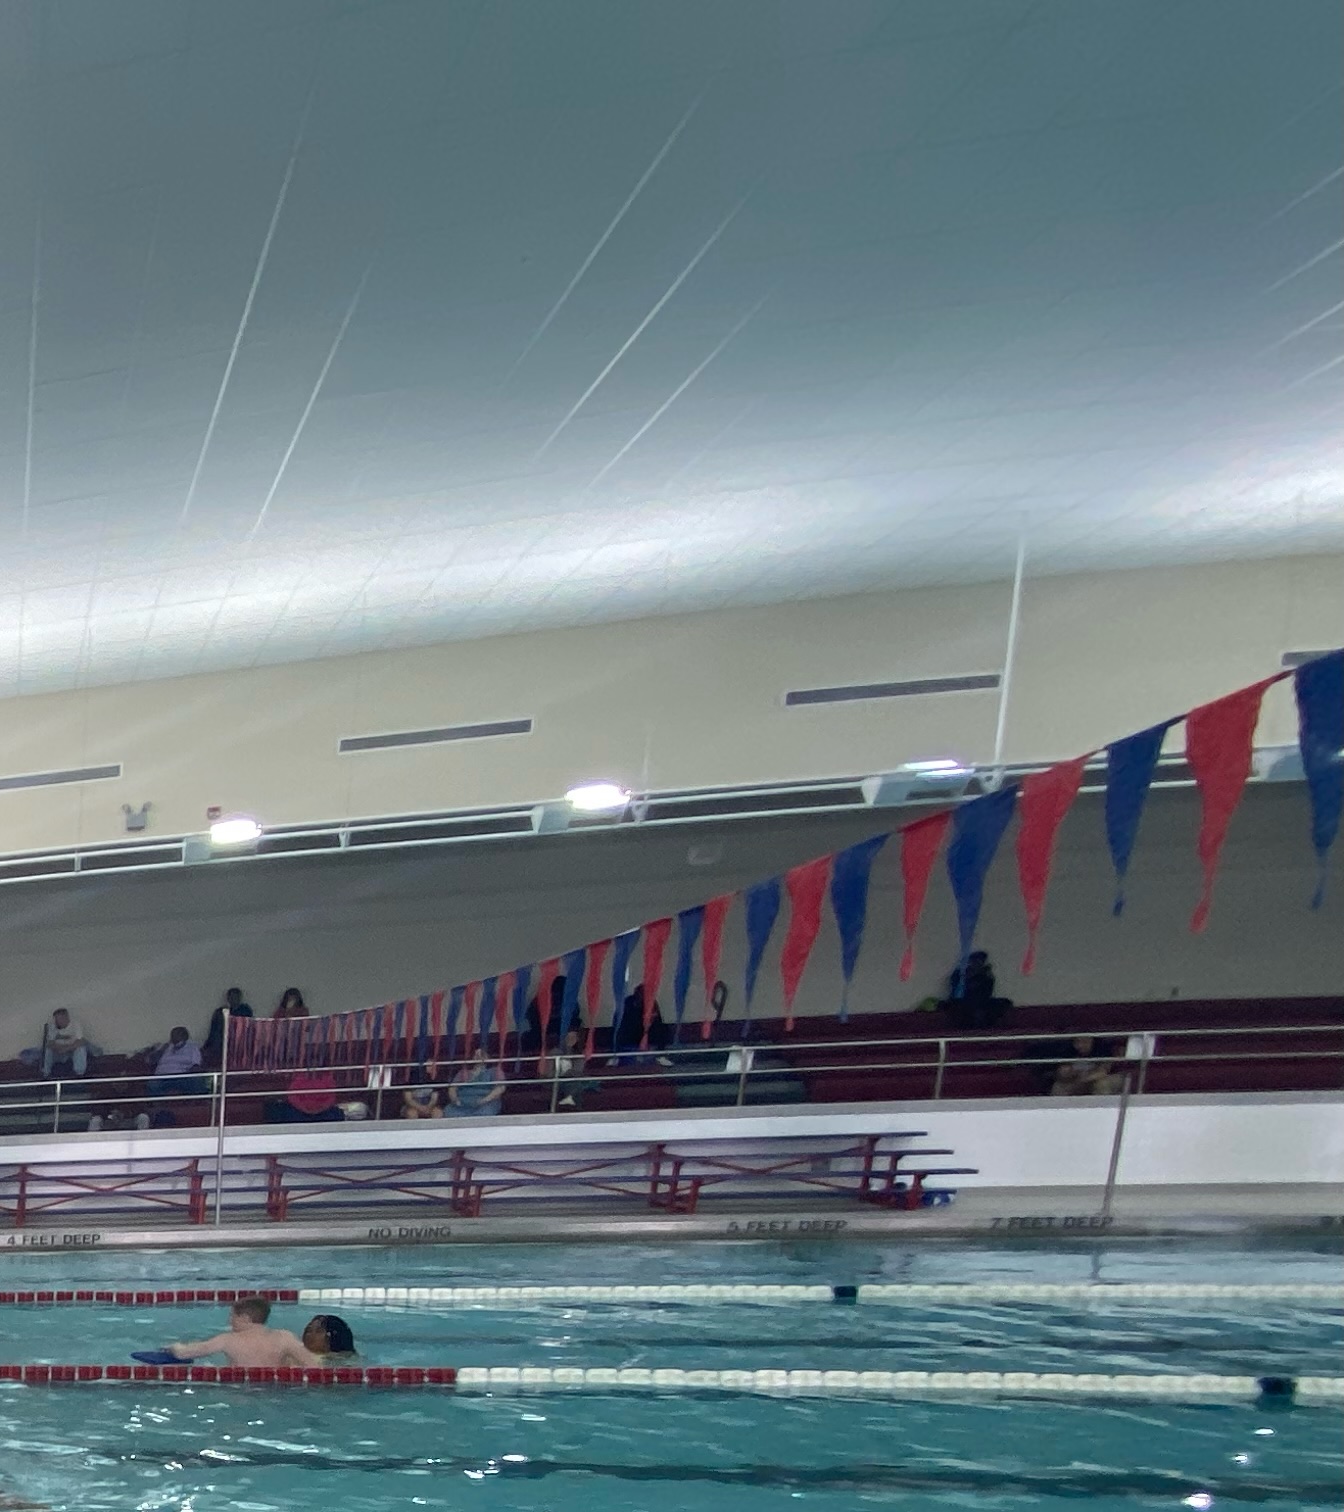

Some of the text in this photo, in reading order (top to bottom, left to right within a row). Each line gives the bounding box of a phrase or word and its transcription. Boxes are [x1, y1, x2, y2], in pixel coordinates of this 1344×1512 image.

[369, 1226, 451, 1238] NO DIVING
[23, 1234, 57, 1245] FEET
[63, 1234, 101, 1245] DEEP
